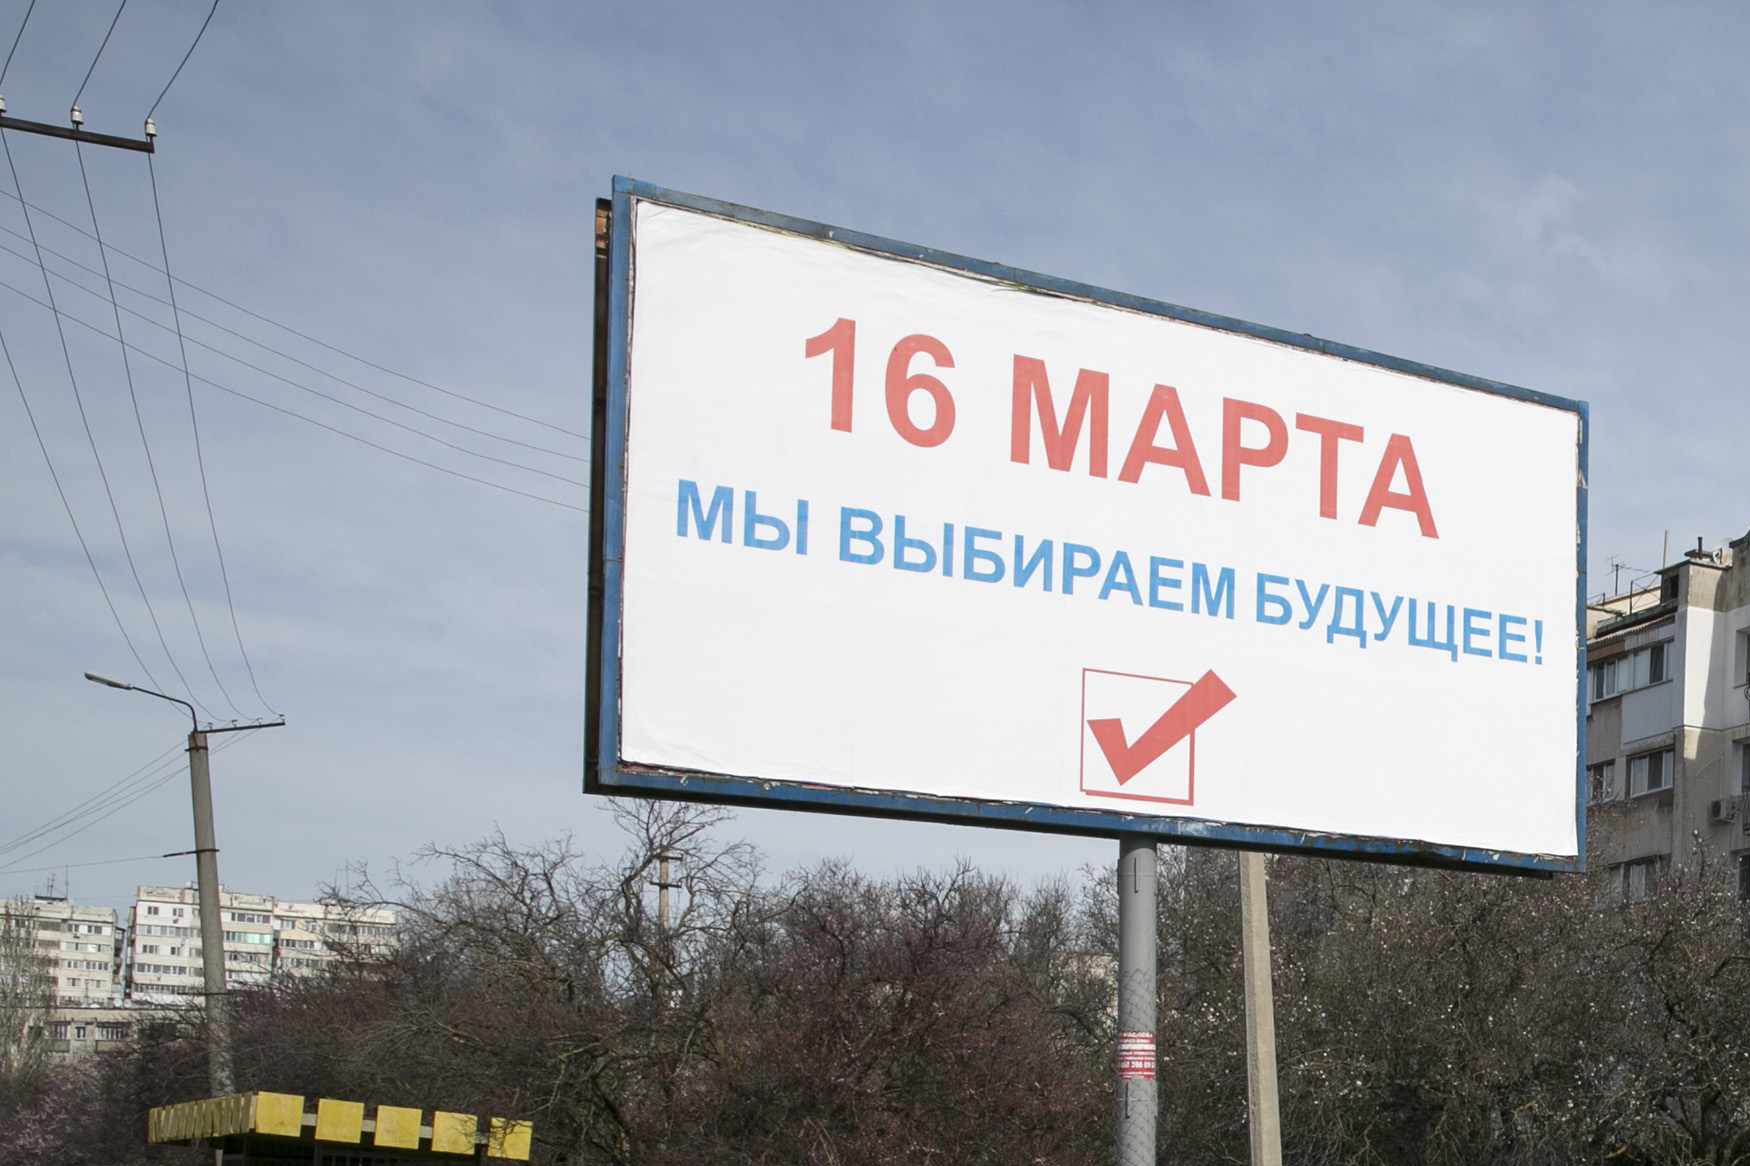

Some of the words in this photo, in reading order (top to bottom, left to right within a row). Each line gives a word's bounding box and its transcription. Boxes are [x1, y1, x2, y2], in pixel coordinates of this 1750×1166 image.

[804, 318, 957, 448] 16
[1010, 355, 1439, 539] МАРТА
[675, 479, 809, 556] МЫ
[839, 506, 1236, 620] ВЫБИРАЕМ
[1255, 572, 1545, 665] БУДУЩЕЕ!
